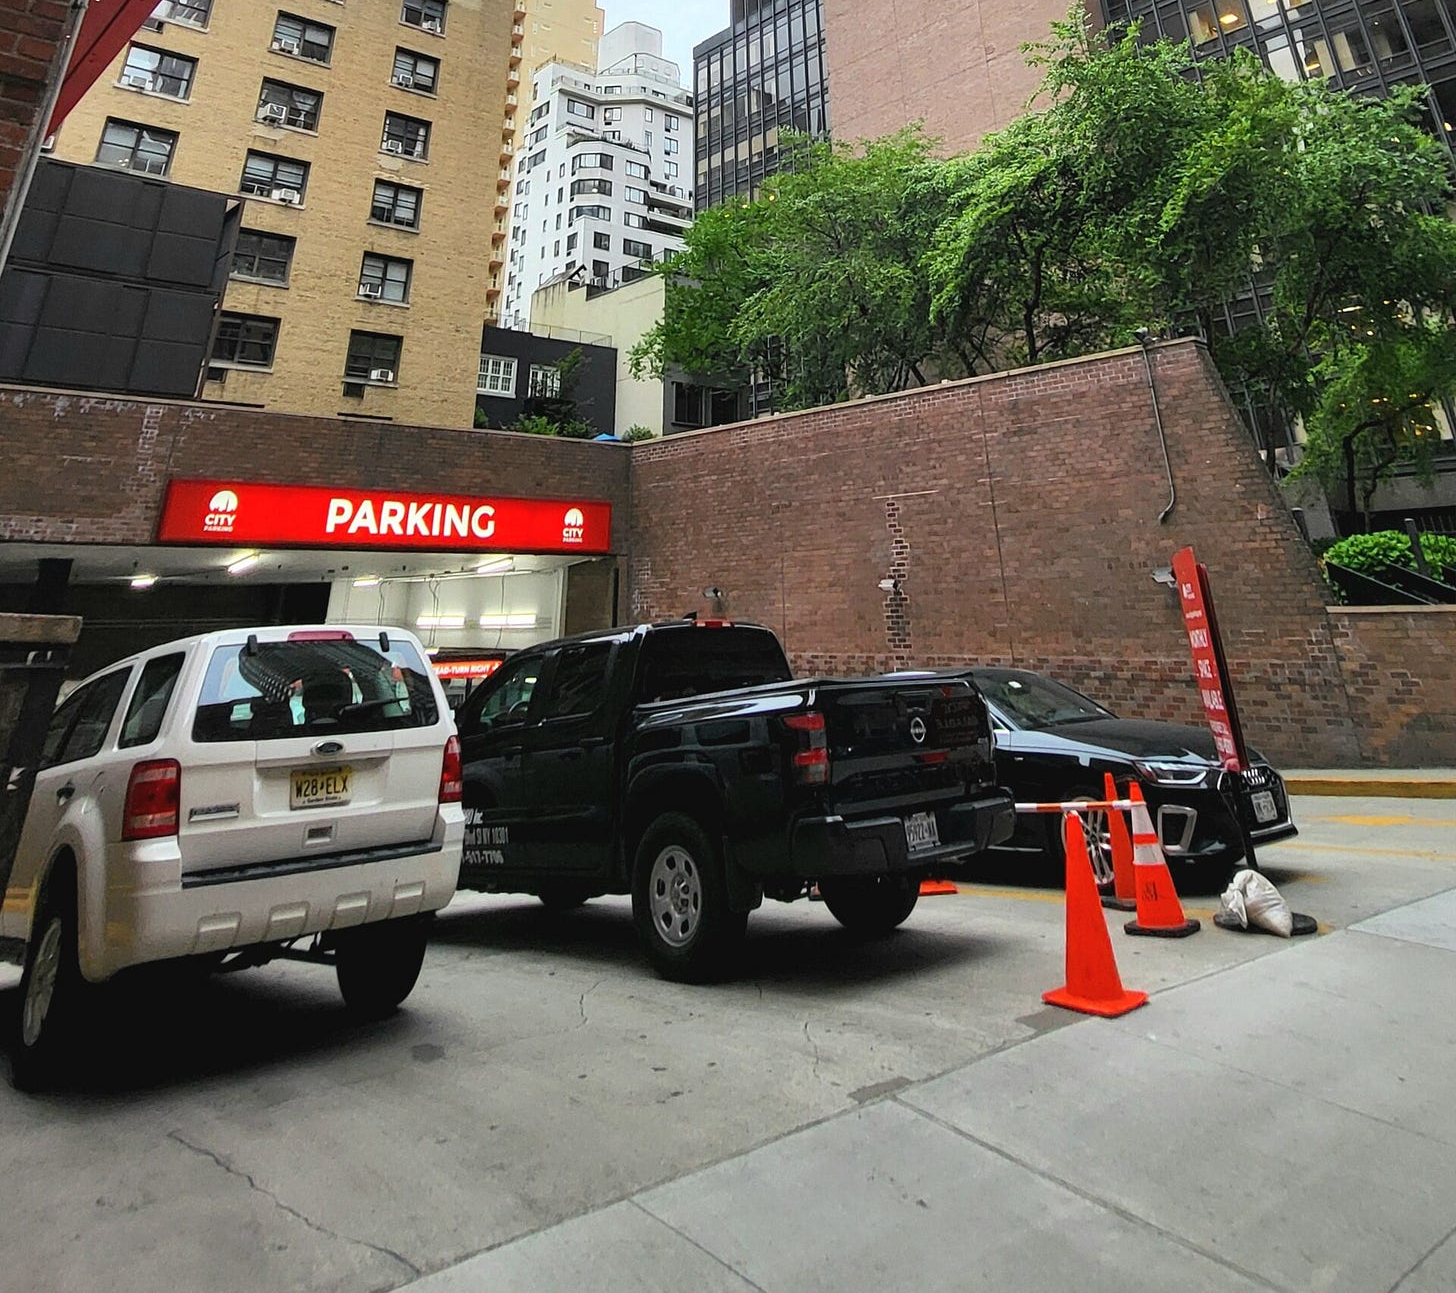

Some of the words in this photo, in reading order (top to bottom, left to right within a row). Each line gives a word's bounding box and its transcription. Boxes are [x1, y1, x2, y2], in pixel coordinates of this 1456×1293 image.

[204, 513, 237, 526] CITY
[325, 498, 496, 539] PARKING
[203, 525, 233, 533] PARKING
[562, 527, 584, 538] CITY
